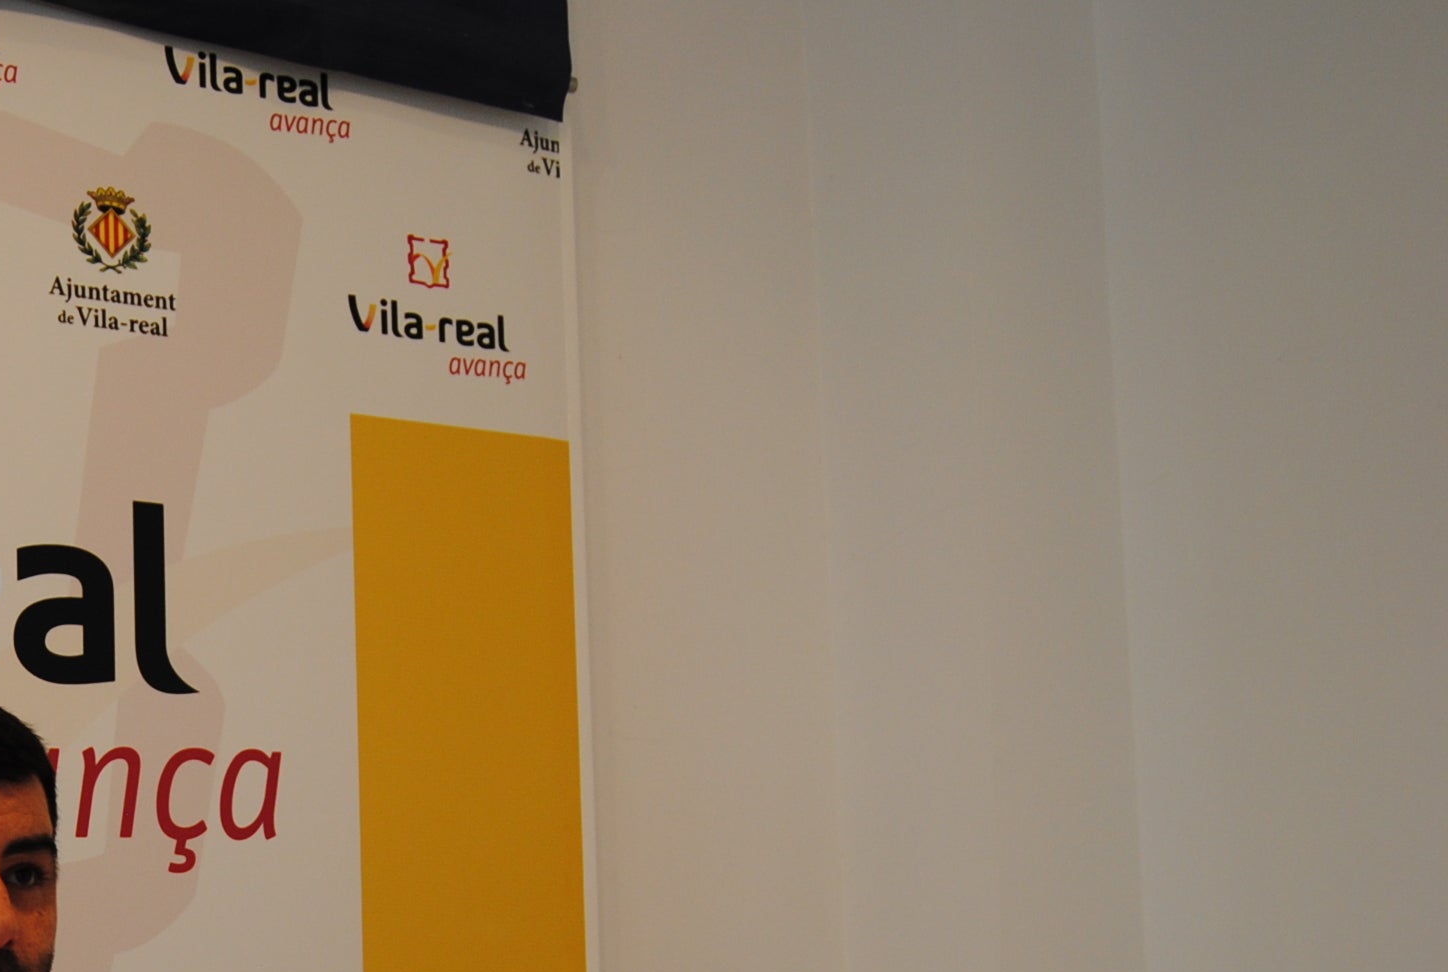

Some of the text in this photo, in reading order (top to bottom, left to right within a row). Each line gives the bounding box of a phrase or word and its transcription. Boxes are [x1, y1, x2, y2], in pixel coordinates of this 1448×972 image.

[164, 45, 333, 110] Vila-real
[269, 112, 351, 144] avança
[527, 160, 541, 174] de
[49, 276, 176, 312] Ajuntament
[57, 306, 168, 338] de Vila-real
[347, 294, 509, 353] Vila-real
[448, 356, 527, 385] avança
[48, 746, 282, 874] nça
